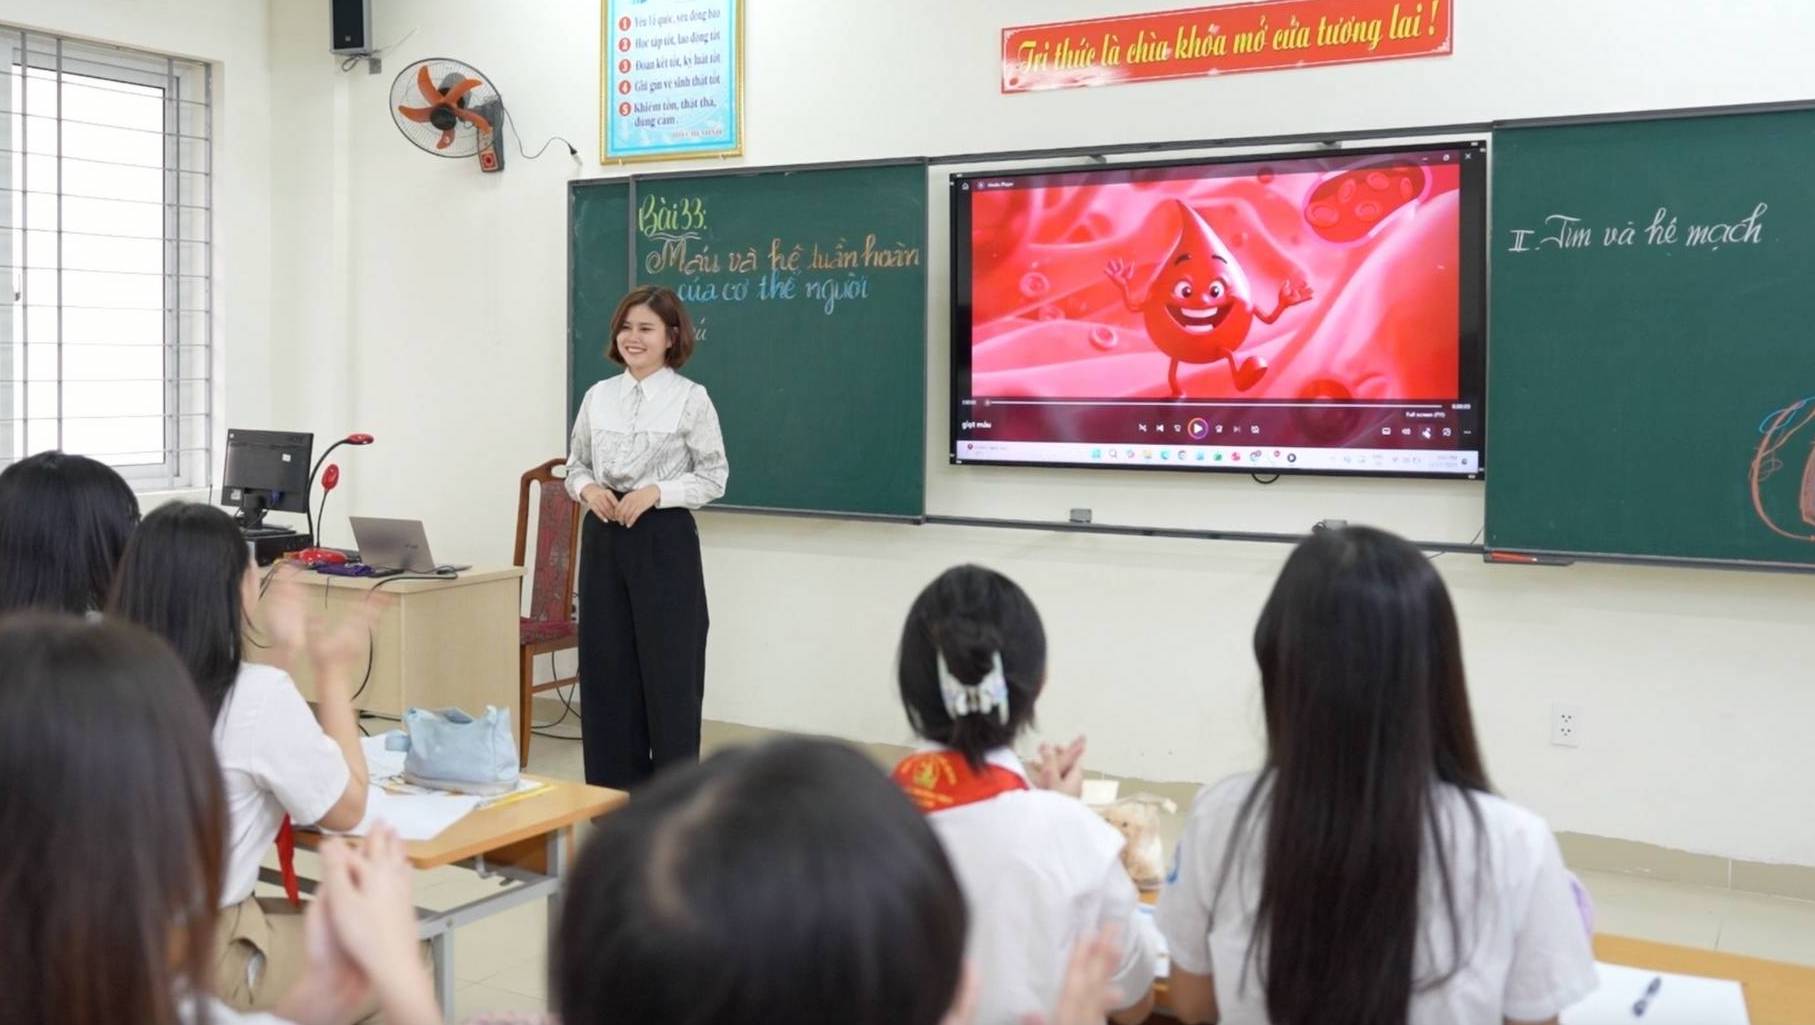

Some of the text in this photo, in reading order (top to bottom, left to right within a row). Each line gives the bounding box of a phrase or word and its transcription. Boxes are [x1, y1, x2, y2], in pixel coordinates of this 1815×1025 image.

[1055, 37, 1096, 70] thức
[1101, 33, 1121, 67] là
[1126, 30, 1169, 64] chìa
[1233, 15, 1269, 54] mở
[1272, 15, 1311, 50] cửa
[1317, 16, 1383, 51] tương
[1388, 3, 1424, 40] lai
[639, 193, 707, 237] Bài 33:
[1540, 214, 1592, 248] Tim
[1686, 202, 1768, 252] mạch
[645, 239, 721, 276] Máu
[728, 246, 758, 273] và
[862, 233, 920, 268] hoàn
